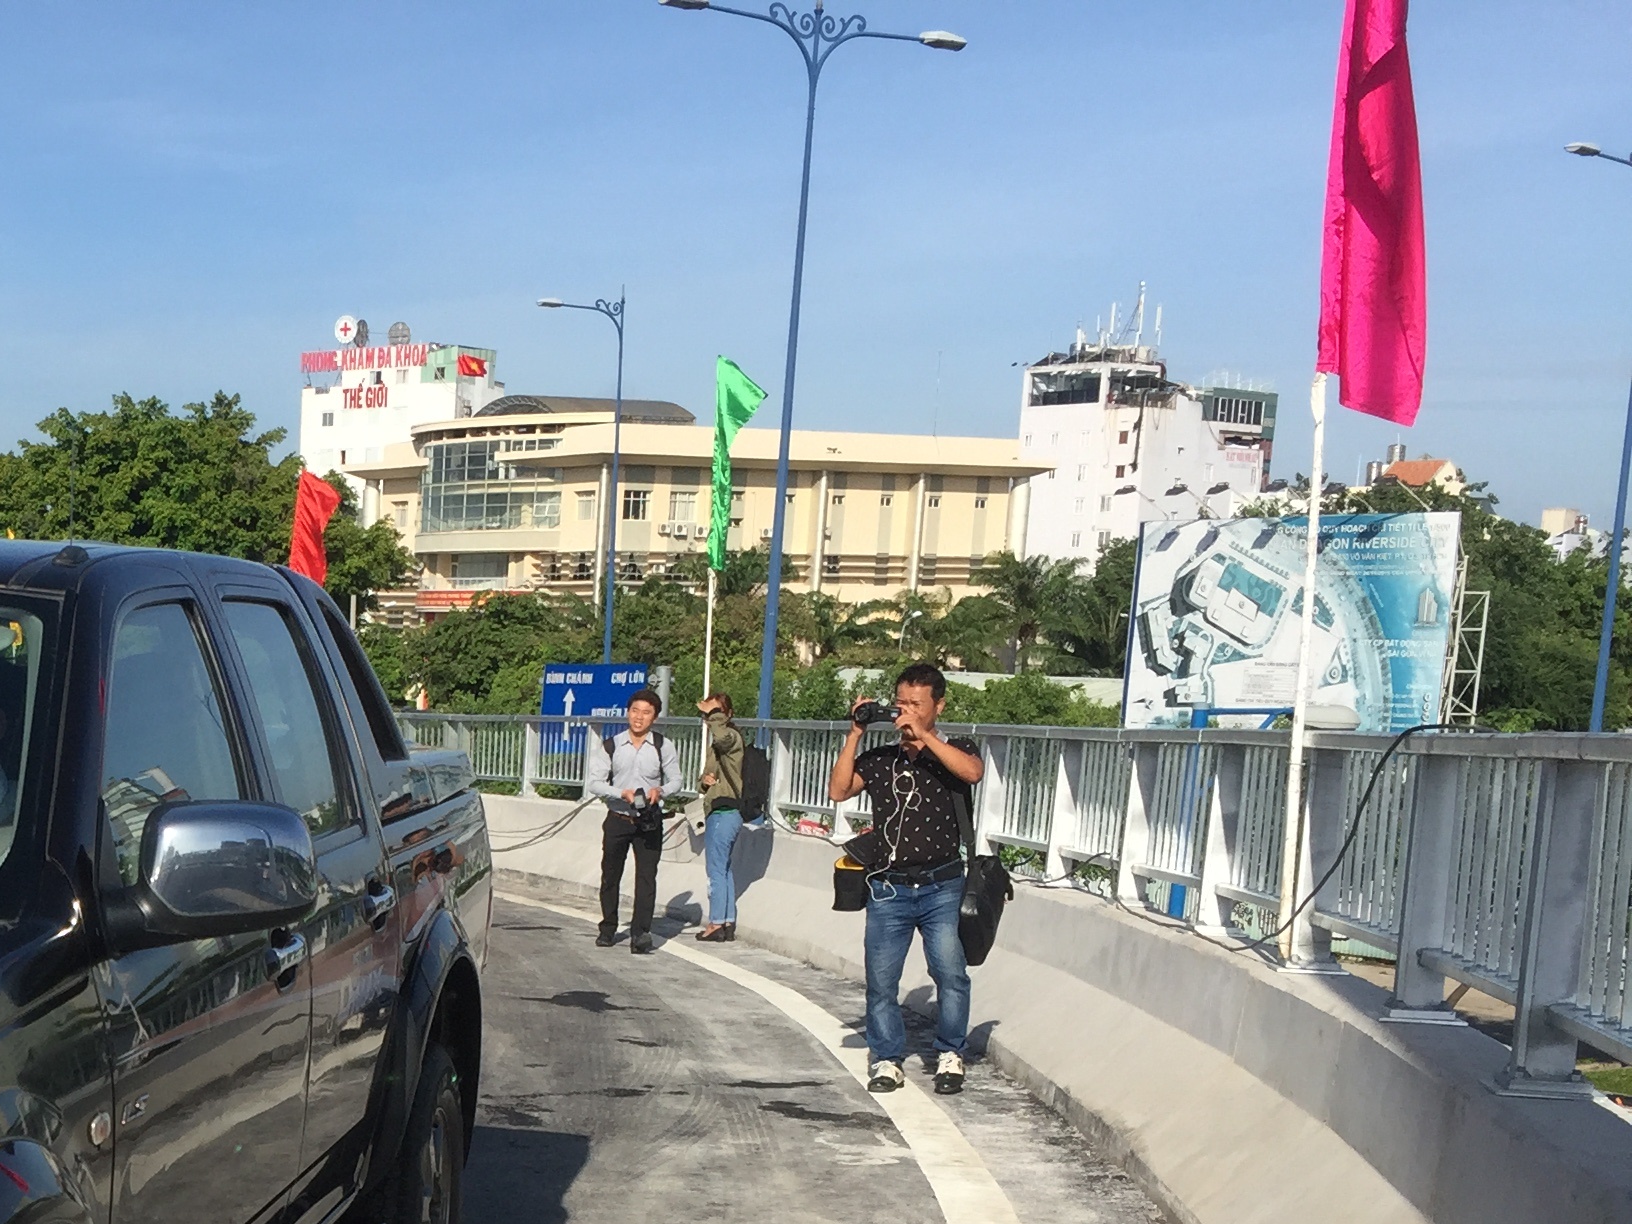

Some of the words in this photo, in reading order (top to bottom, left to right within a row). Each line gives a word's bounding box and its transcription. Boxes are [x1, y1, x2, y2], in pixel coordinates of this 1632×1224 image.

[377, 346, 391, 369] ĐA
[395, 344, 427, 368] KHOA
[343, 377, 365, 409] THẾ
[1352, 536, 1416, 550] RIVERSIDE
[1420, 535, 1447, 549] CITY
[611, 671, 627, 686] CHỢ
